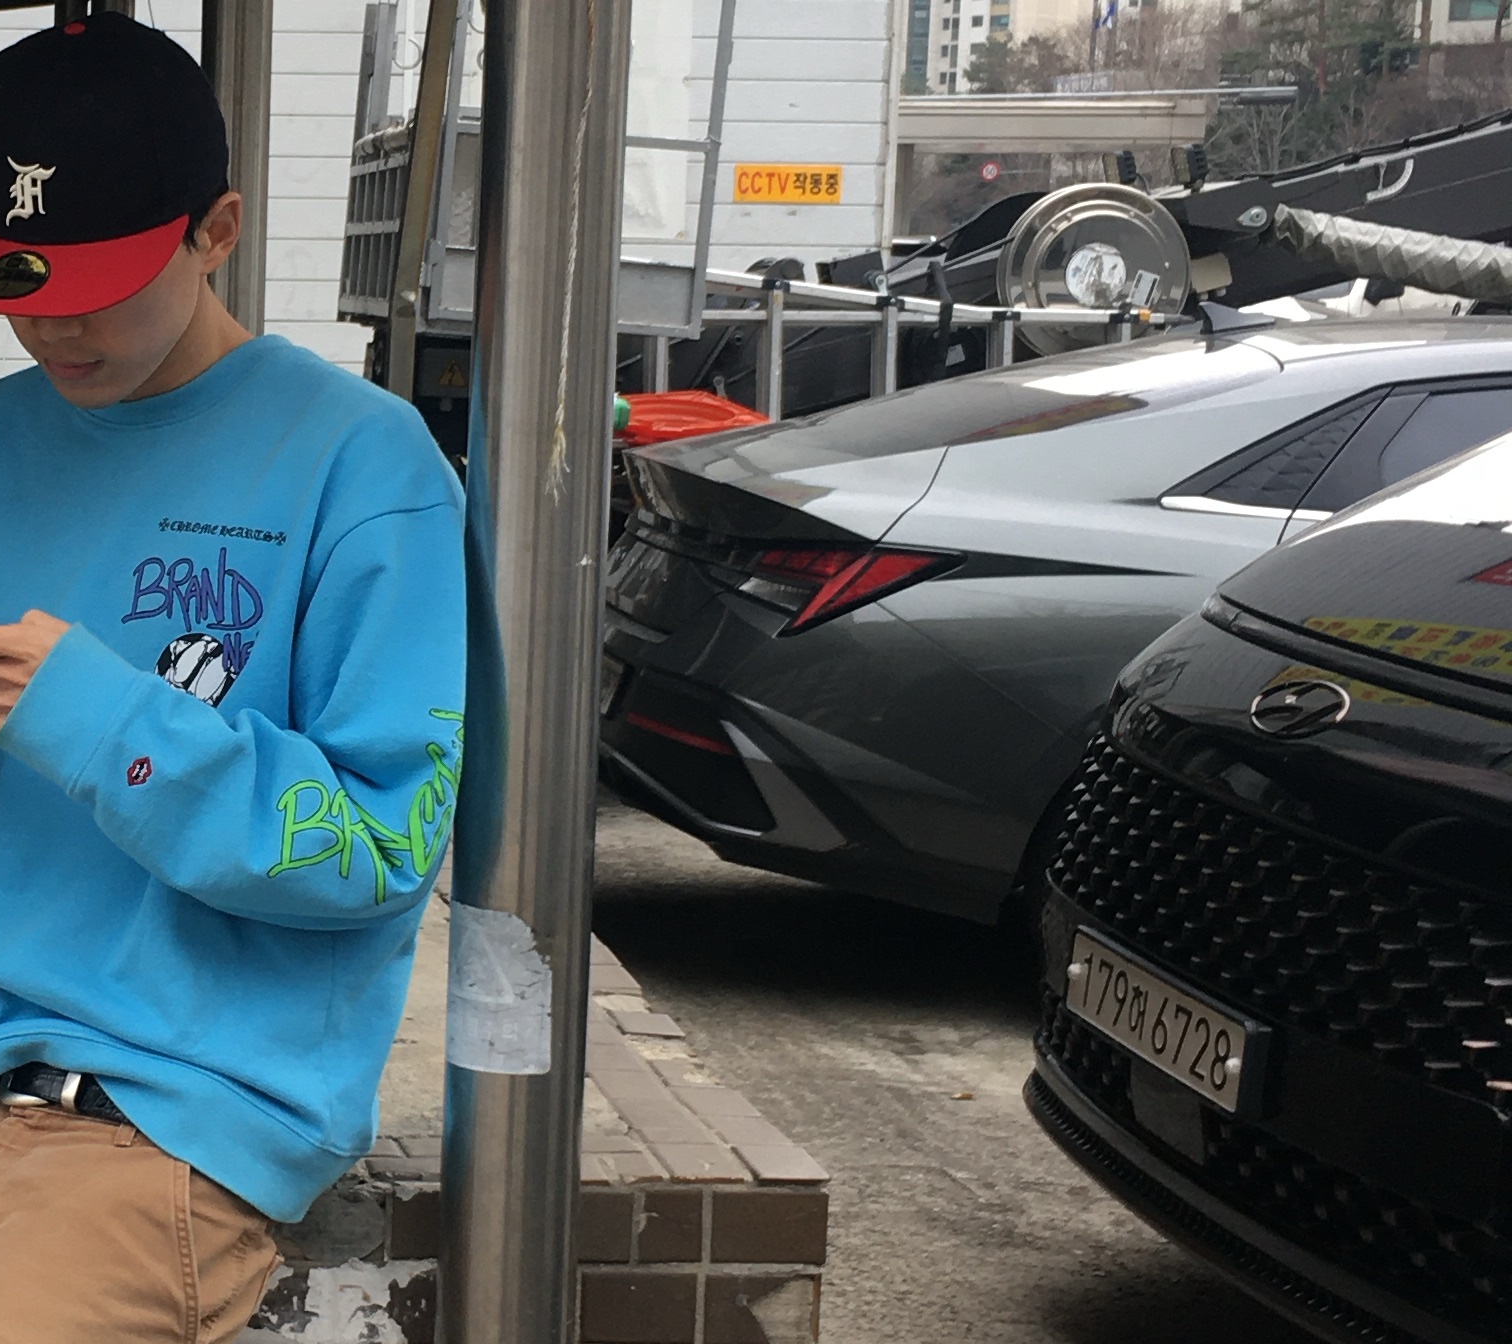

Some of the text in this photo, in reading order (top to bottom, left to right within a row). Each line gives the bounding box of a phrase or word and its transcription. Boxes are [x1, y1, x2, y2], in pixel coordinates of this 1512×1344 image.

[170, 520, 275, 543] CHROME HEARTS
[121, 546, 263, 632] BRAND
[1083, 952, 1232, 1092] 179허6728
